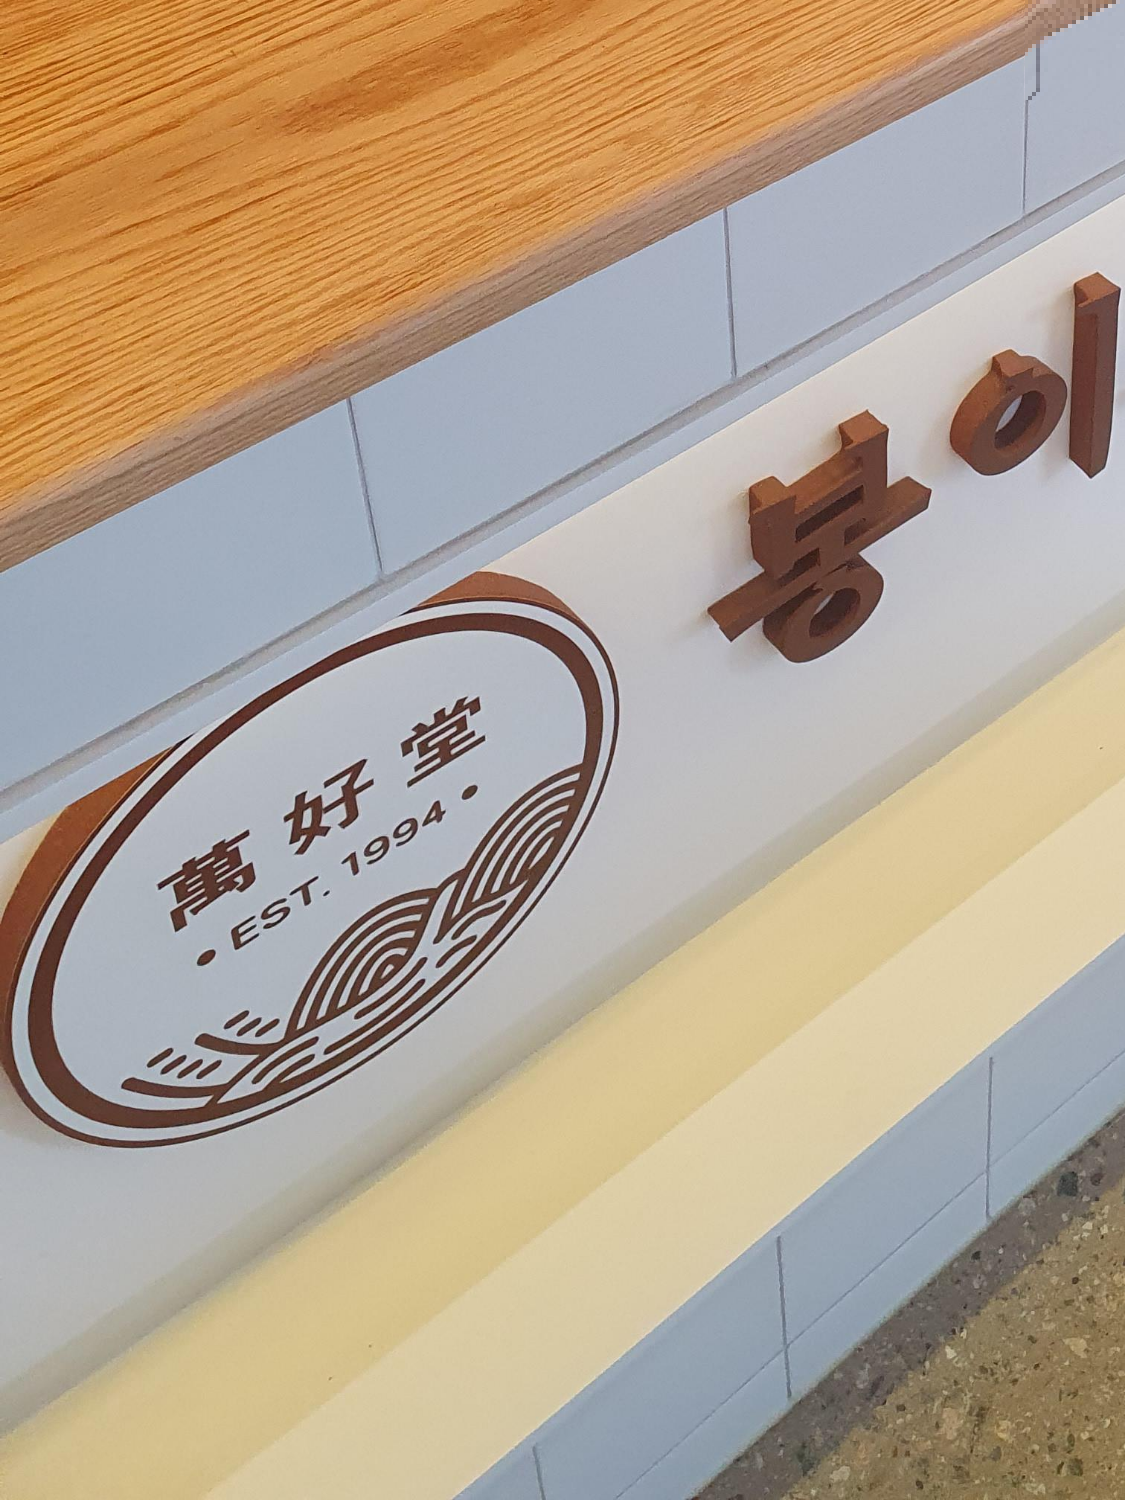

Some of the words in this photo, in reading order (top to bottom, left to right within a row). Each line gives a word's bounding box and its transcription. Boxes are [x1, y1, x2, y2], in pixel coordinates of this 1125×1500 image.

[157, 696, 486, 932] 萬好堂
[230, 876, 331, 950] EST.
[341, 800, 446, 876] 1994
